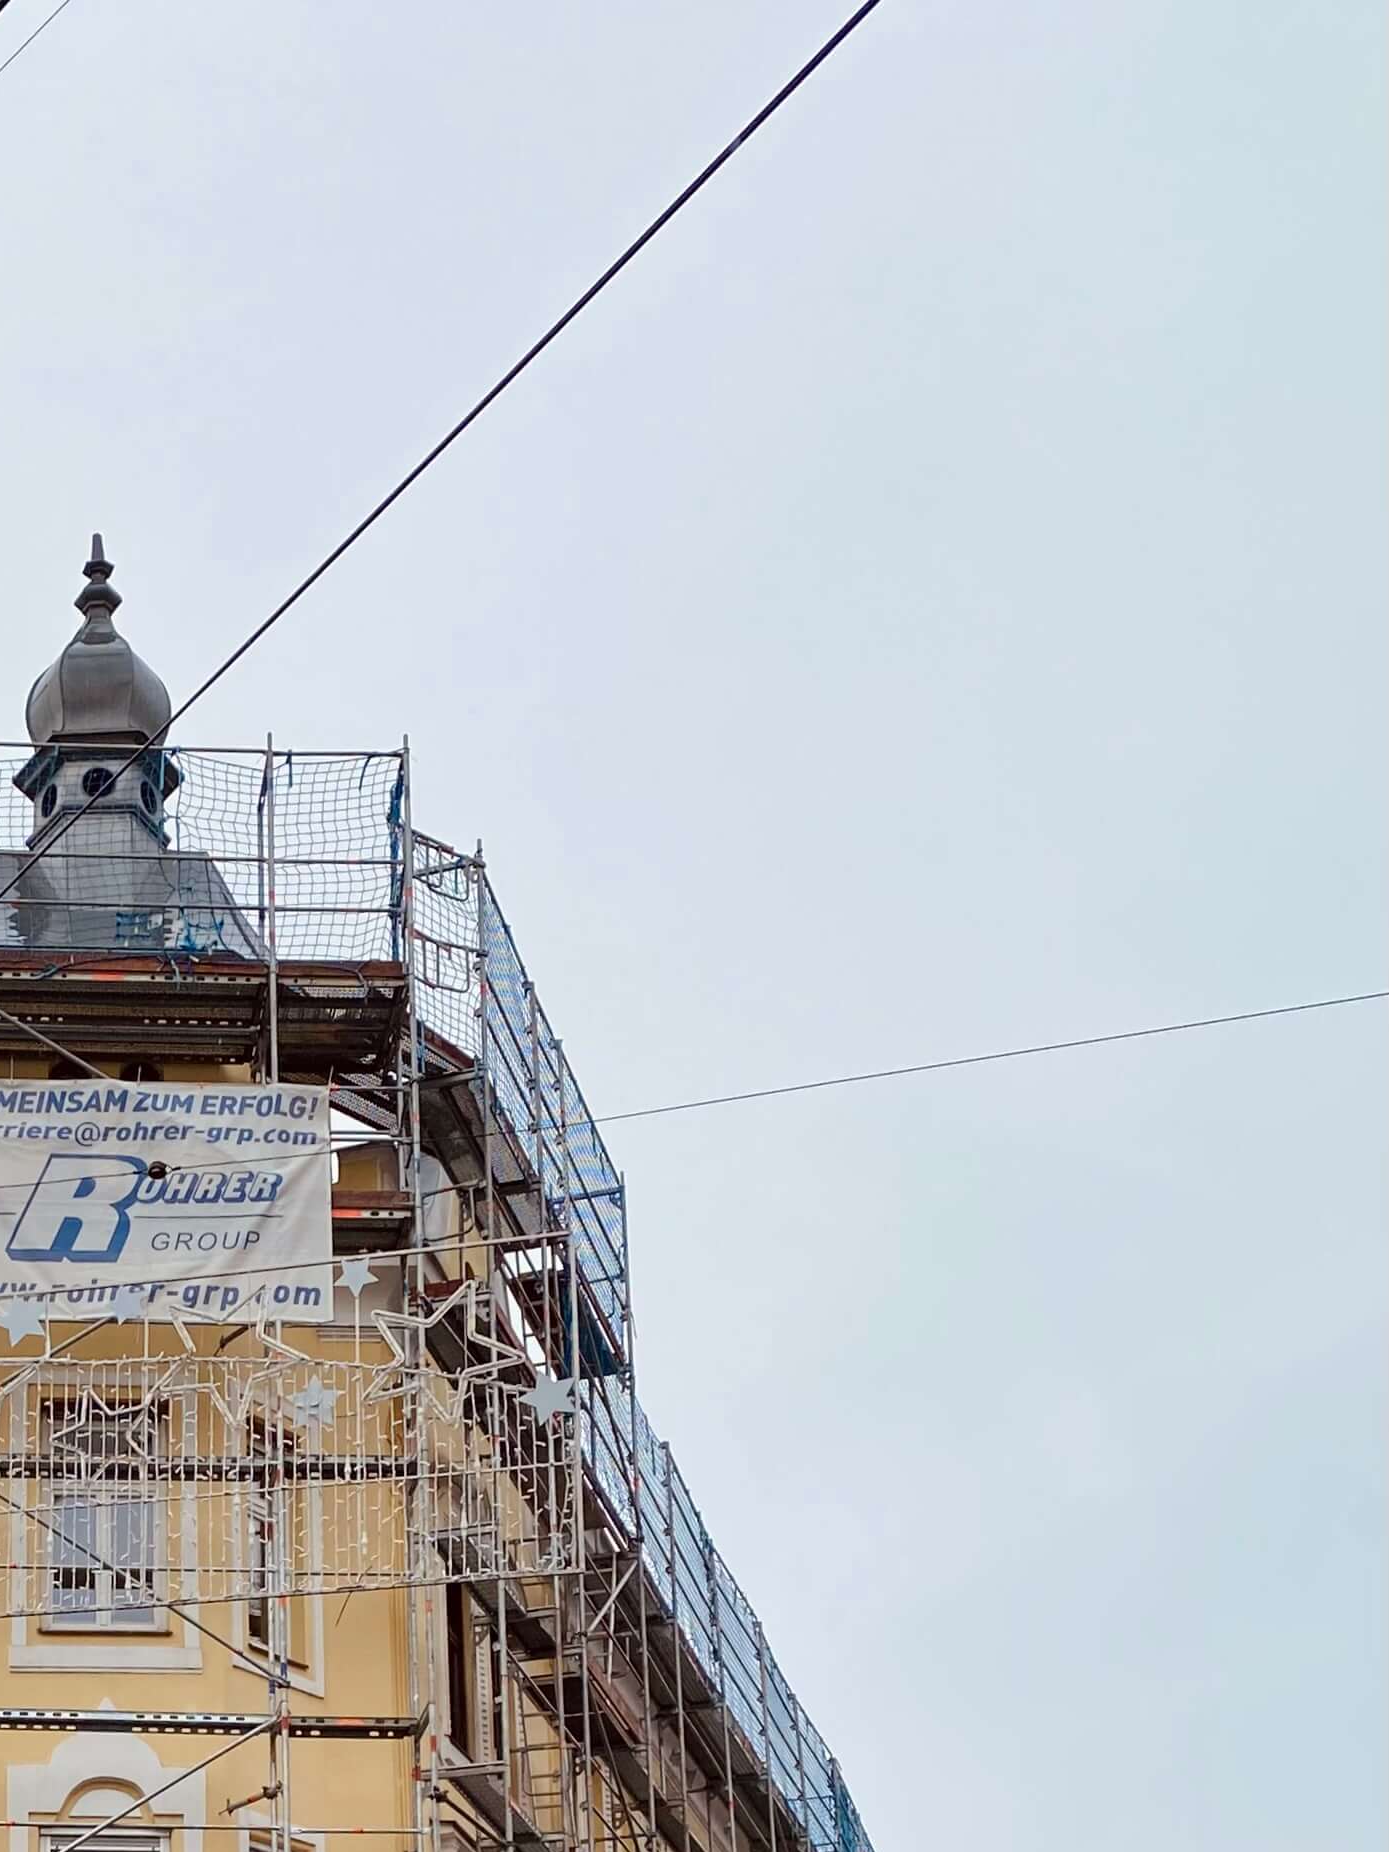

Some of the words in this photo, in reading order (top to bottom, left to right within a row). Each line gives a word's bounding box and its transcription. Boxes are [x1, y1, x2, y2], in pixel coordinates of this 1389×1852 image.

[132, 1091, 195, 1114] ZUM
[200, 1093, 319, 1121] ERFOLG!
[150, 1231, 261, 1252] GROUP
